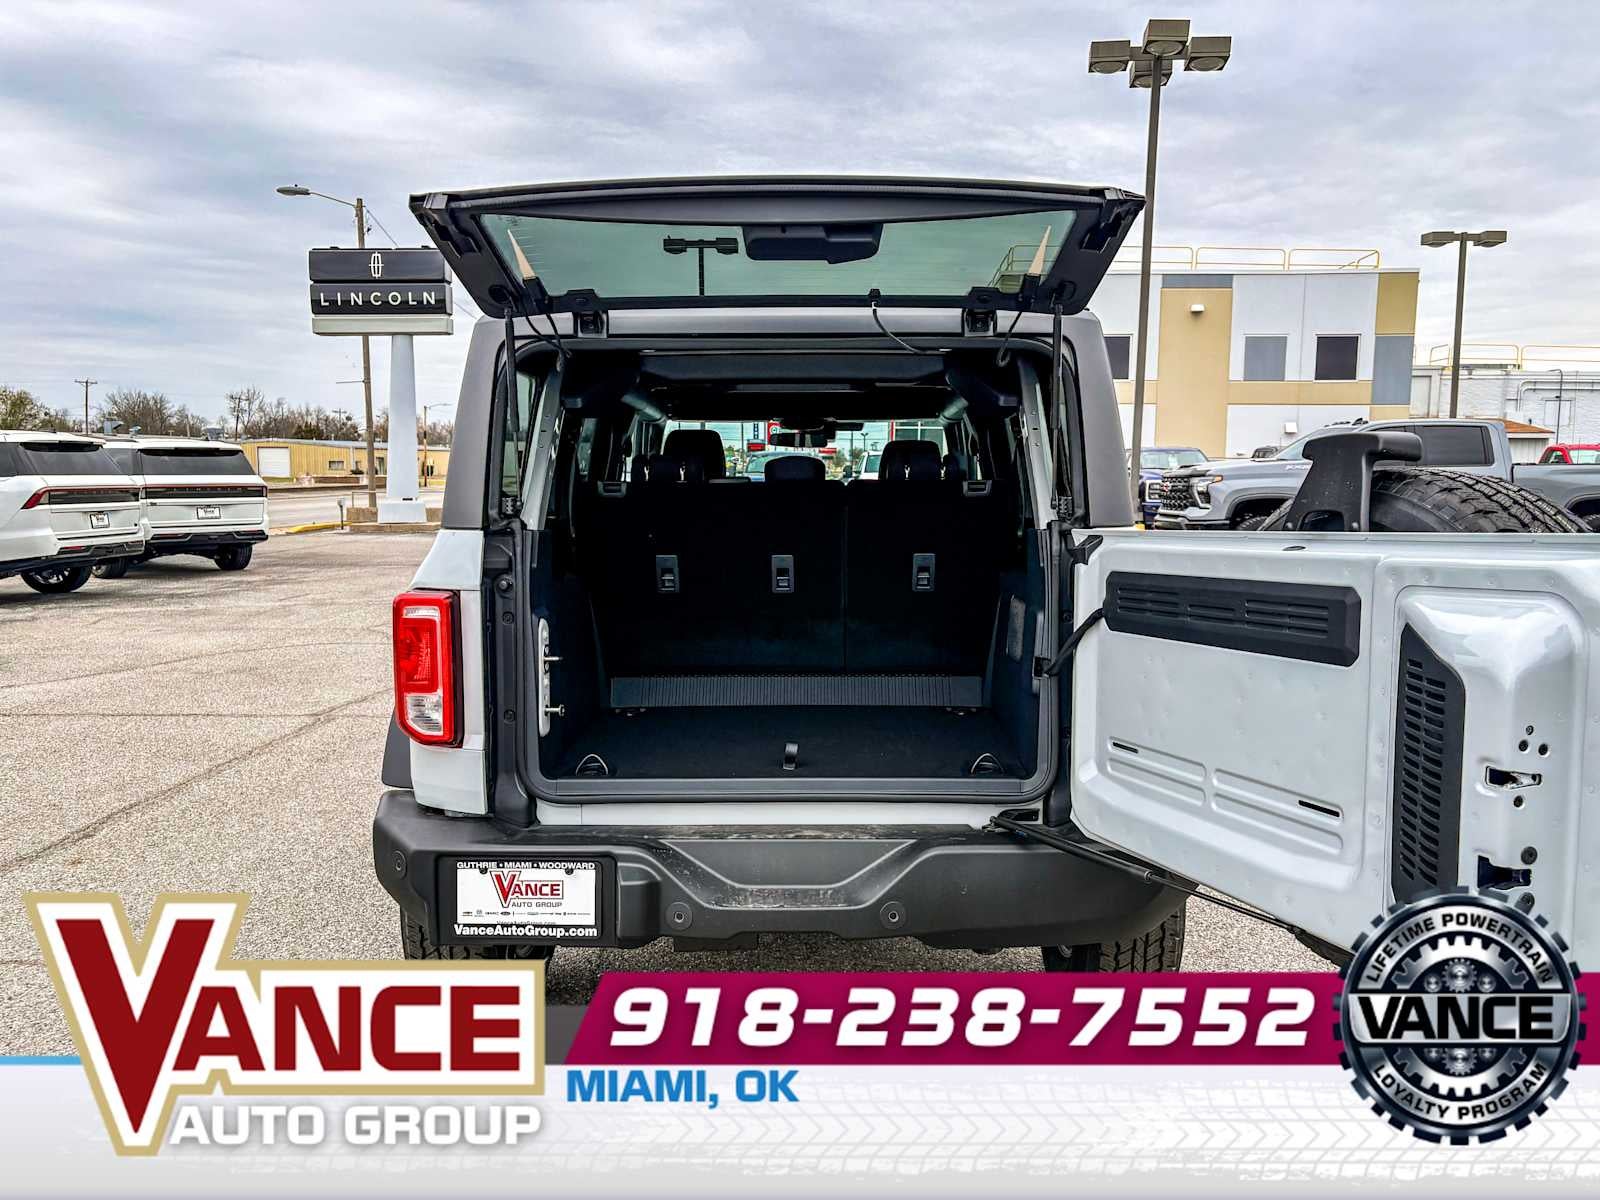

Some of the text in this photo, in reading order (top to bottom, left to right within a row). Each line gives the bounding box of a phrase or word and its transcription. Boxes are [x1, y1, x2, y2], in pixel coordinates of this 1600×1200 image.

[320, 291, 436, 306] LINCOLN
[456, 861, 596, 869] GUTHRIE MIAMI WOODWARD
[494, 873, 561, 905] VANCE
[454, 924, 598, 938] VanceAutoGroup.com
